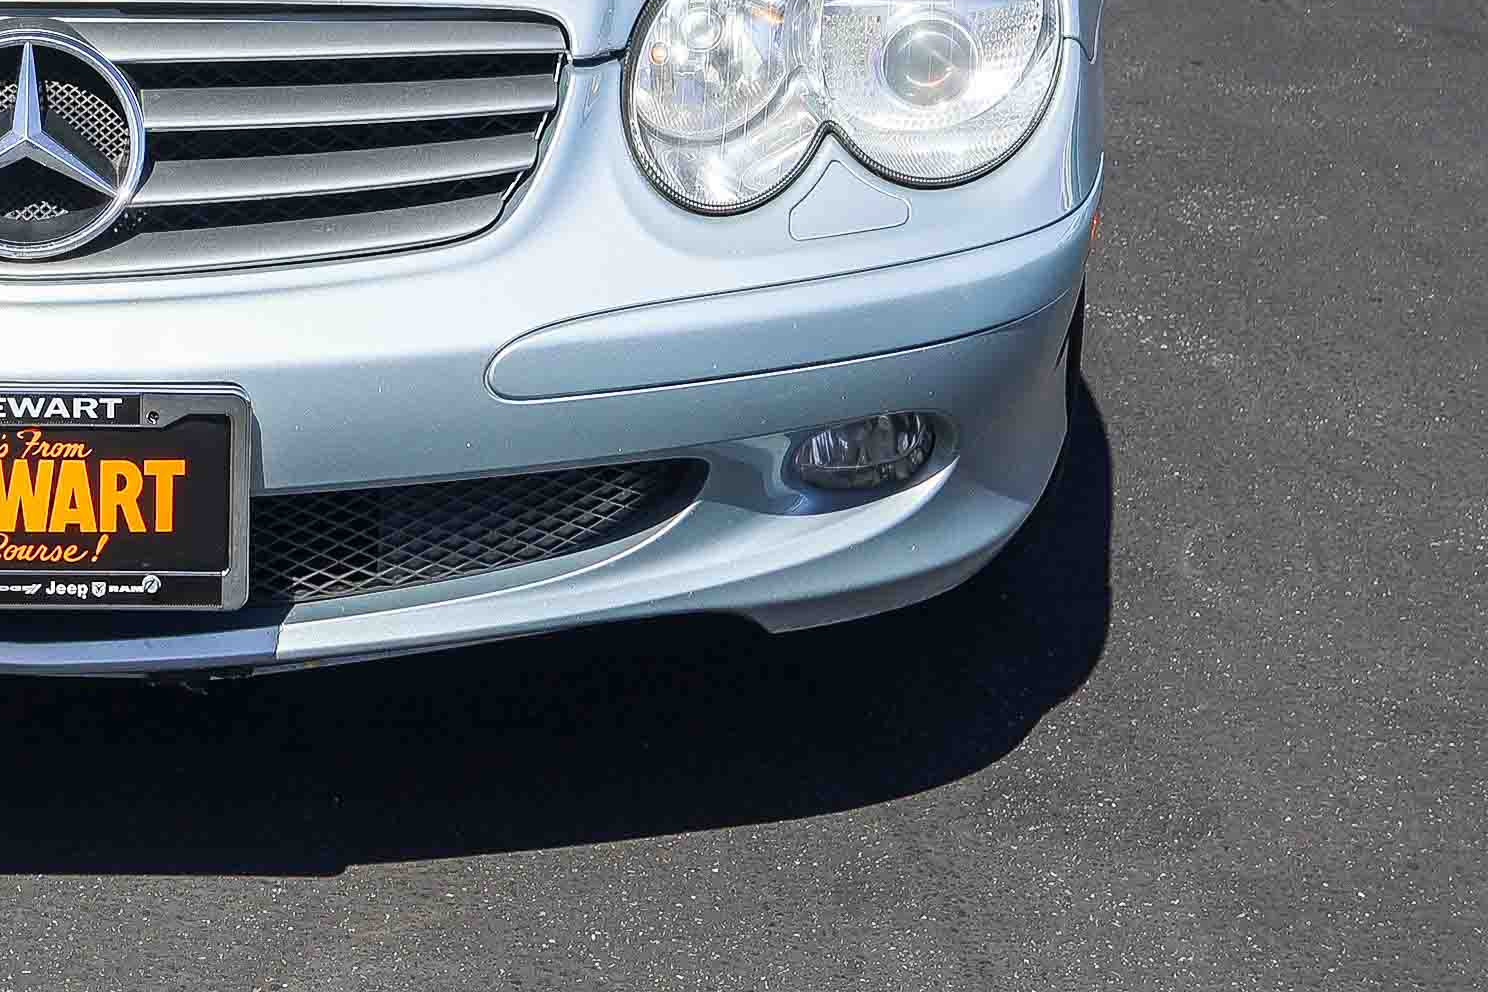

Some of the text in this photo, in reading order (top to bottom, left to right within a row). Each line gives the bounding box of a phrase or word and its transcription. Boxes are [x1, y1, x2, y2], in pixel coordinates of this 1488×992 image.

[16, 428, 93, 459] From
[45, 581, 89, 598] Jeep
[108, 584, 145, 593] RAM
